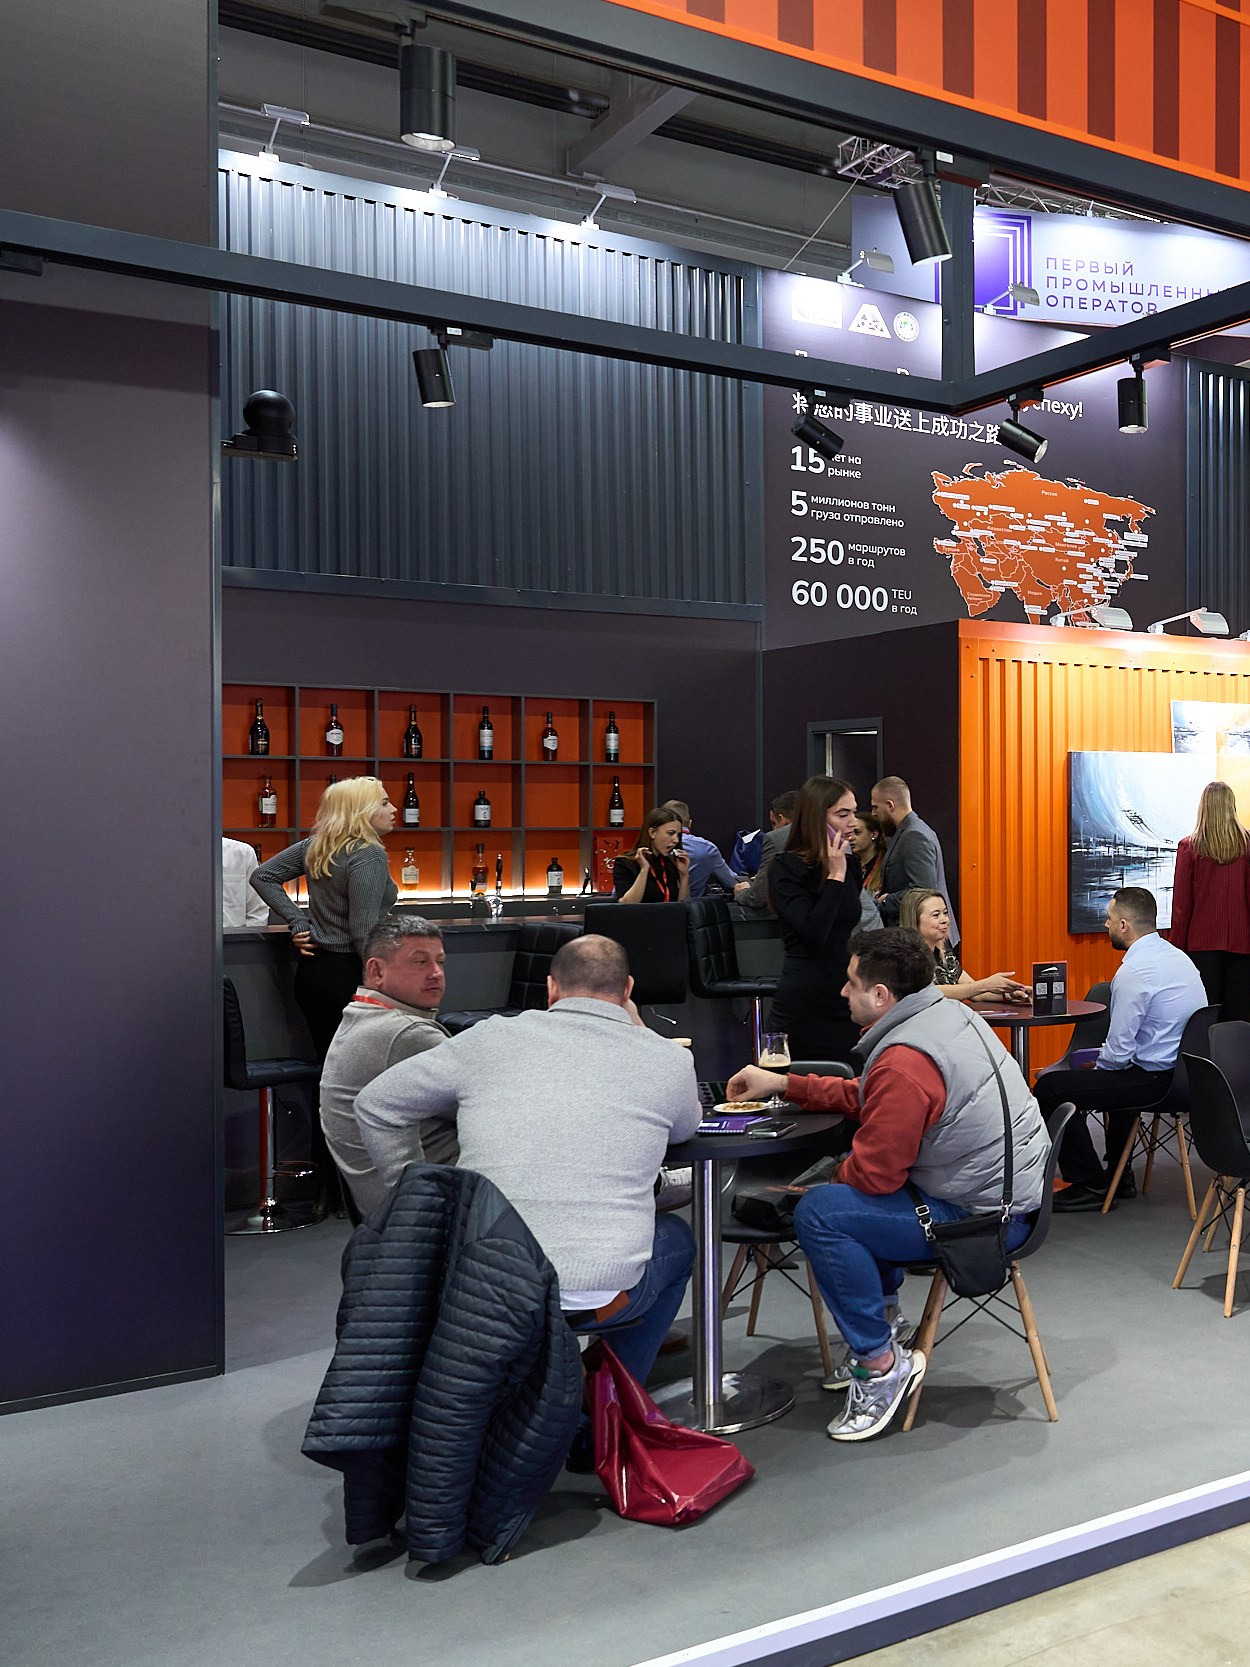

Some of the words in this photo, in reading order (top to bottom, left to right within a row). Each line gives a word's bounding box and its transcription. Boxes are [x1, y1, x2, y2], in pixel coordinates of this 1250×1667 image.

[1046, 257, 1134, 276] ПЕРВЫЙ
[1046, 276, 1219, 300] ПРОМЫШЛЕНН
[1046, 295, 1158, 314] ОПЕРАТОР
[1022, 398, 1083, 421] спеху!
[790, 445, 826, 474] 15
[847, 455, 862, 465] на
[827, 467, 862, 479] рынке
[790, 490, 809, 516] 5
[810, 494, 870, 510] миллионов
[871, 502, 896, 513] тонн
[810, 509, 841, 522] груза
[843, 512, 905, 528] отправлено
[790, 535, 845, 566] 250
[848, 543, 906, 557] маршрутов
[848, 557, 855, 565] в
[856, 558, 876, 569] год
[791, 579, 828, 607] 60
[836, 583, 889, 612] 000
[891, 588, 912, 600] TEU
[891, 605, 898, 613] в
[900, 605, 918, 616] год
